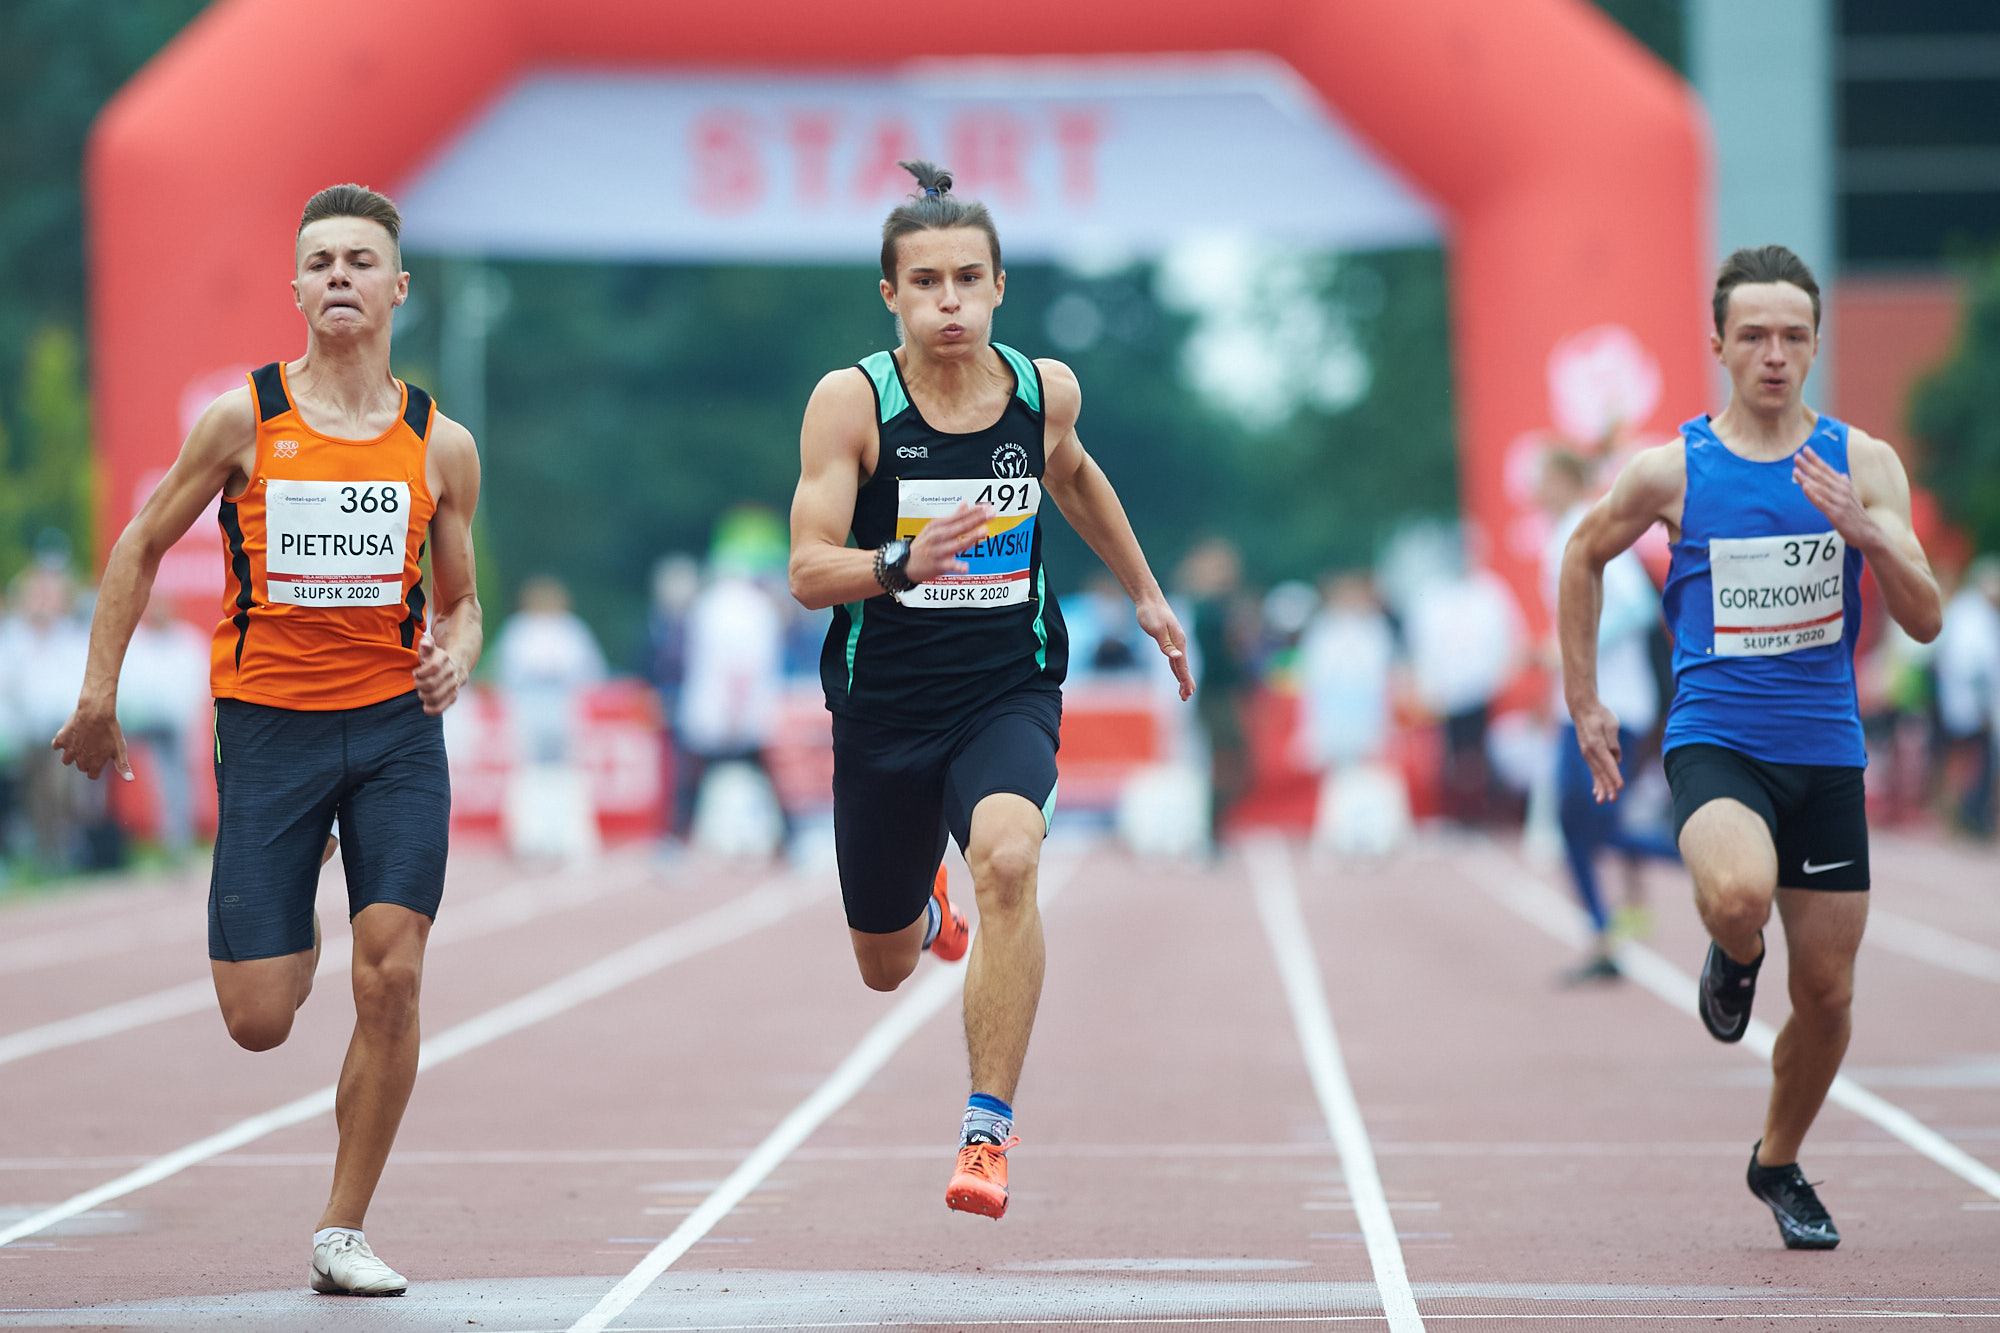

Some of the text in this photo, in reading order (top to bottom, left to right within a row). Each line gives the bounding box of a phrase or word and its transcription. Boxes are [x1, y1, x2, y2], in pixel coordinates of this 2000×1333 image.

[688, 106, 1112, 212] START
[340, 486, 399, 513] 368
[975, 484, 1029, 512] 491
[281, 533, 394, 556] PIETRUSA
[1784, 537, 1837, 566] 376
[294, 586, 380, 599] SŁUPSK 2020
[924, 586, 1009, 600] SŁUPSK 2020
[1720, 575, 1840, 609] GORZKOWICZ
[1743, 628, 1825, 649] SŁUPSK 2020
